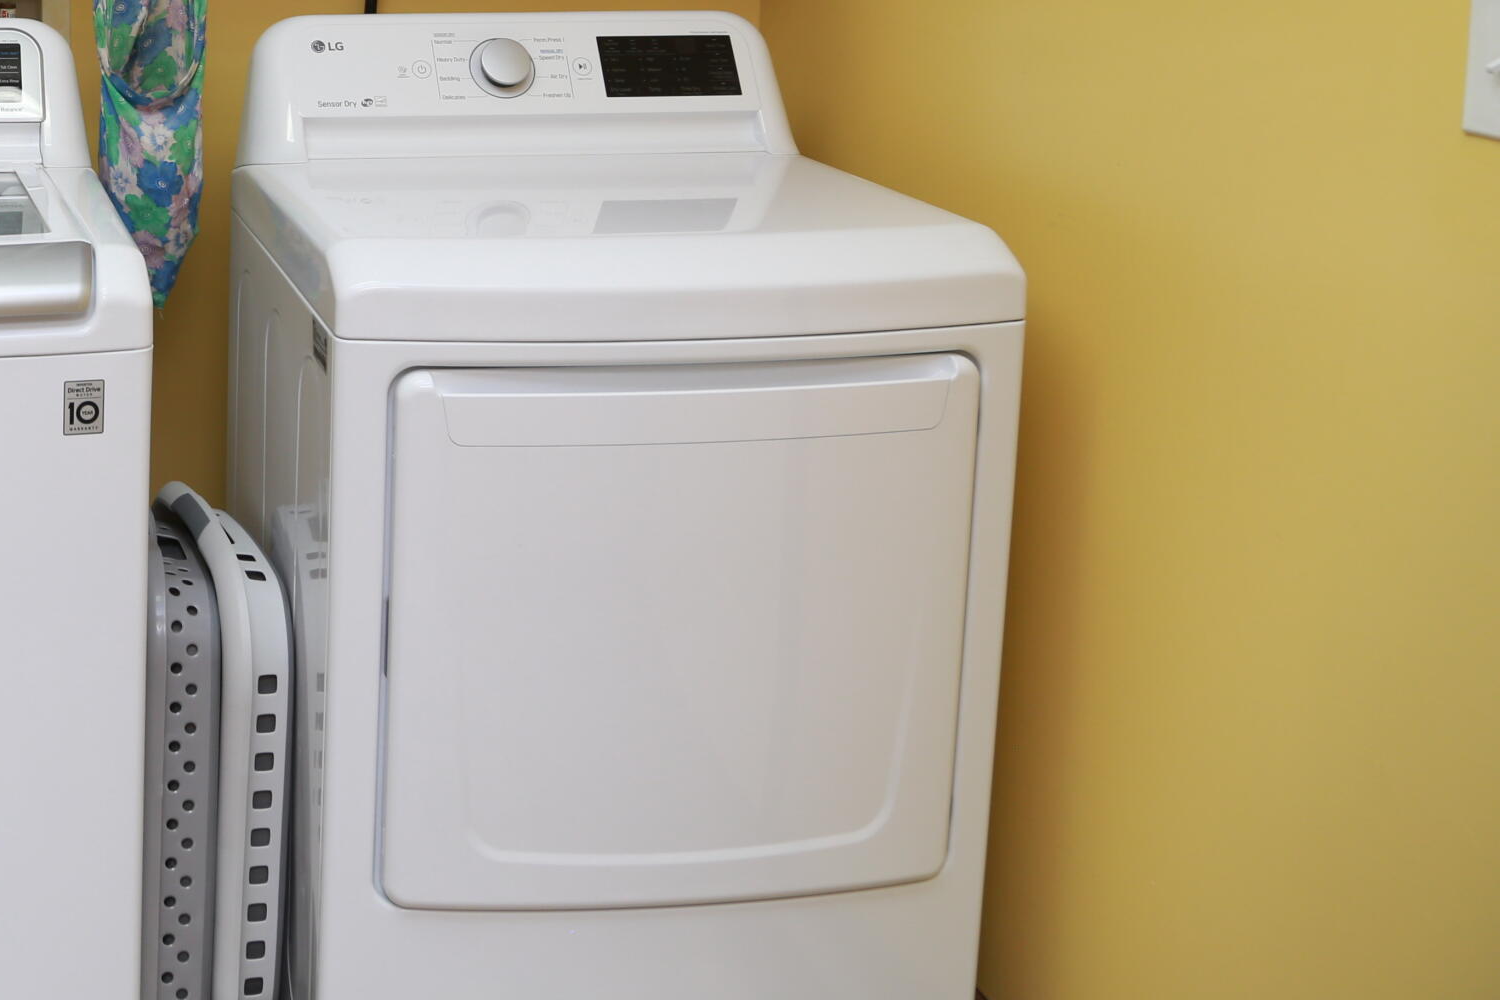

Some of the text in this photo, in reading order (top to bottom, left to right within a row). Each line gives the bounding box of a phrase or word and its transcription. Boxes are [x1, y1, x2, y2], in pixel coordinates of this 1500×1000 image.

[328, 42, 344, 51] LG
[318, 100, 357, 108] Sensor Dry
[68, 401, 100, 425] 10
